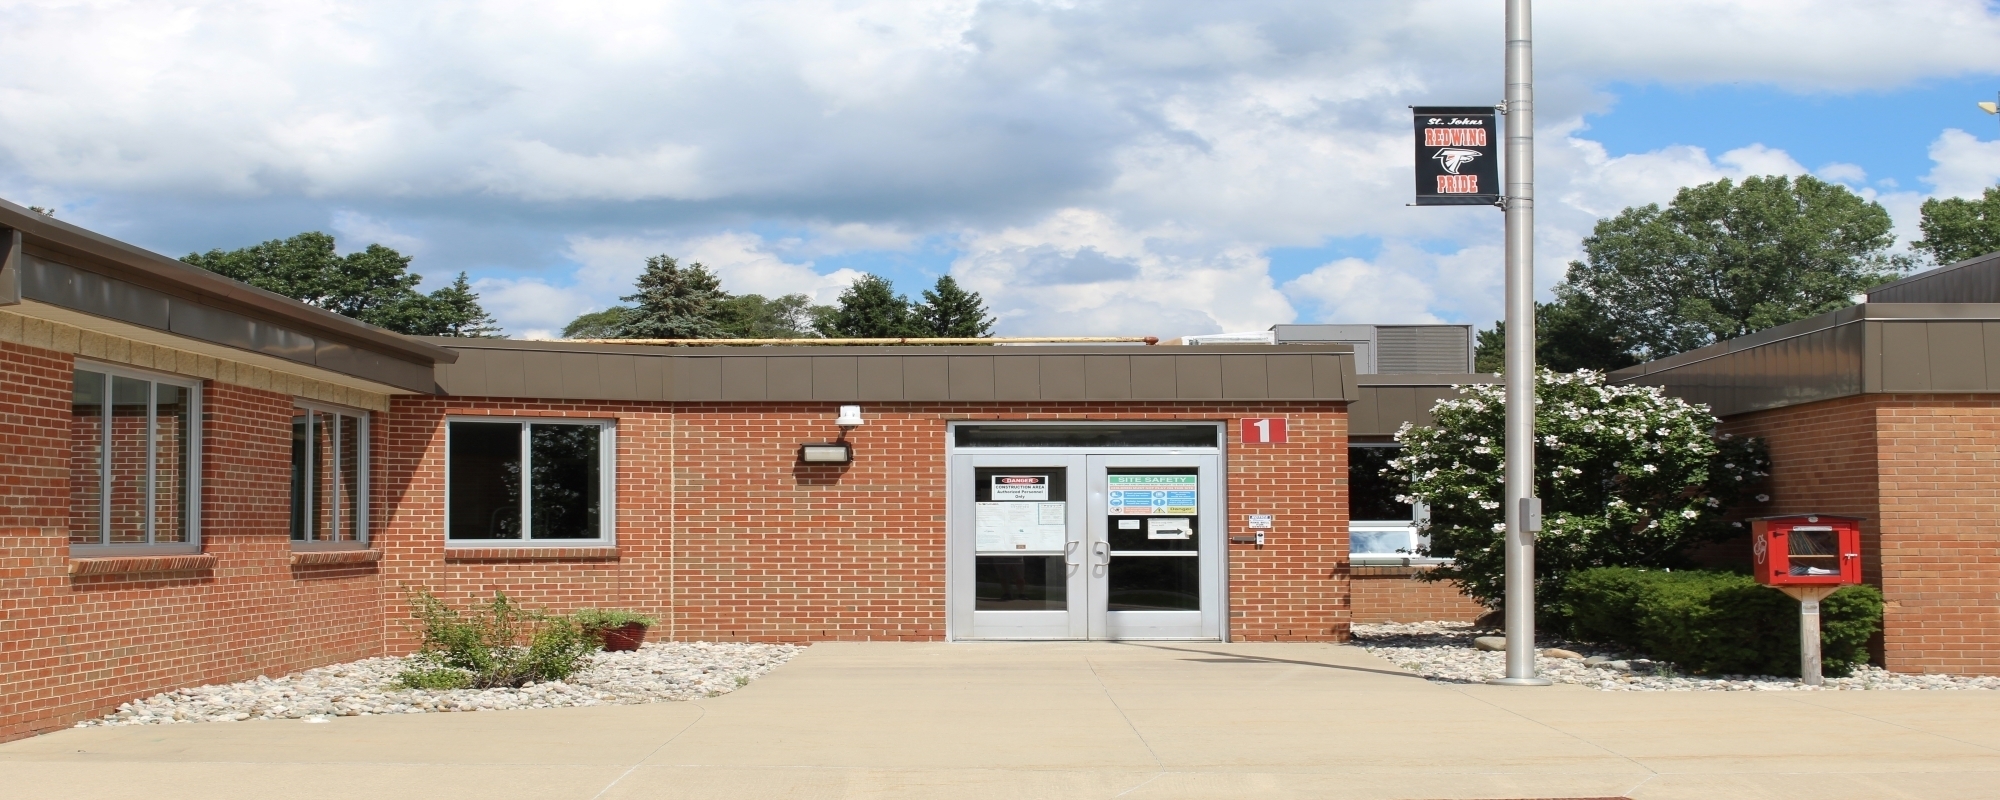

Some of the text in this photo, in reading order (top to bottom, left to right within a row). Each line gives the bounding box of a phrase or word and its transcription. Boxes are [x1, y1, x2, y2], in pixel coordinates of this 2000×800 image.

[1425, 128, 1486, 146] REDWING
[1437, 175, 1478, 193] PRIDE
[1254, 419, 1269, 442] 1
